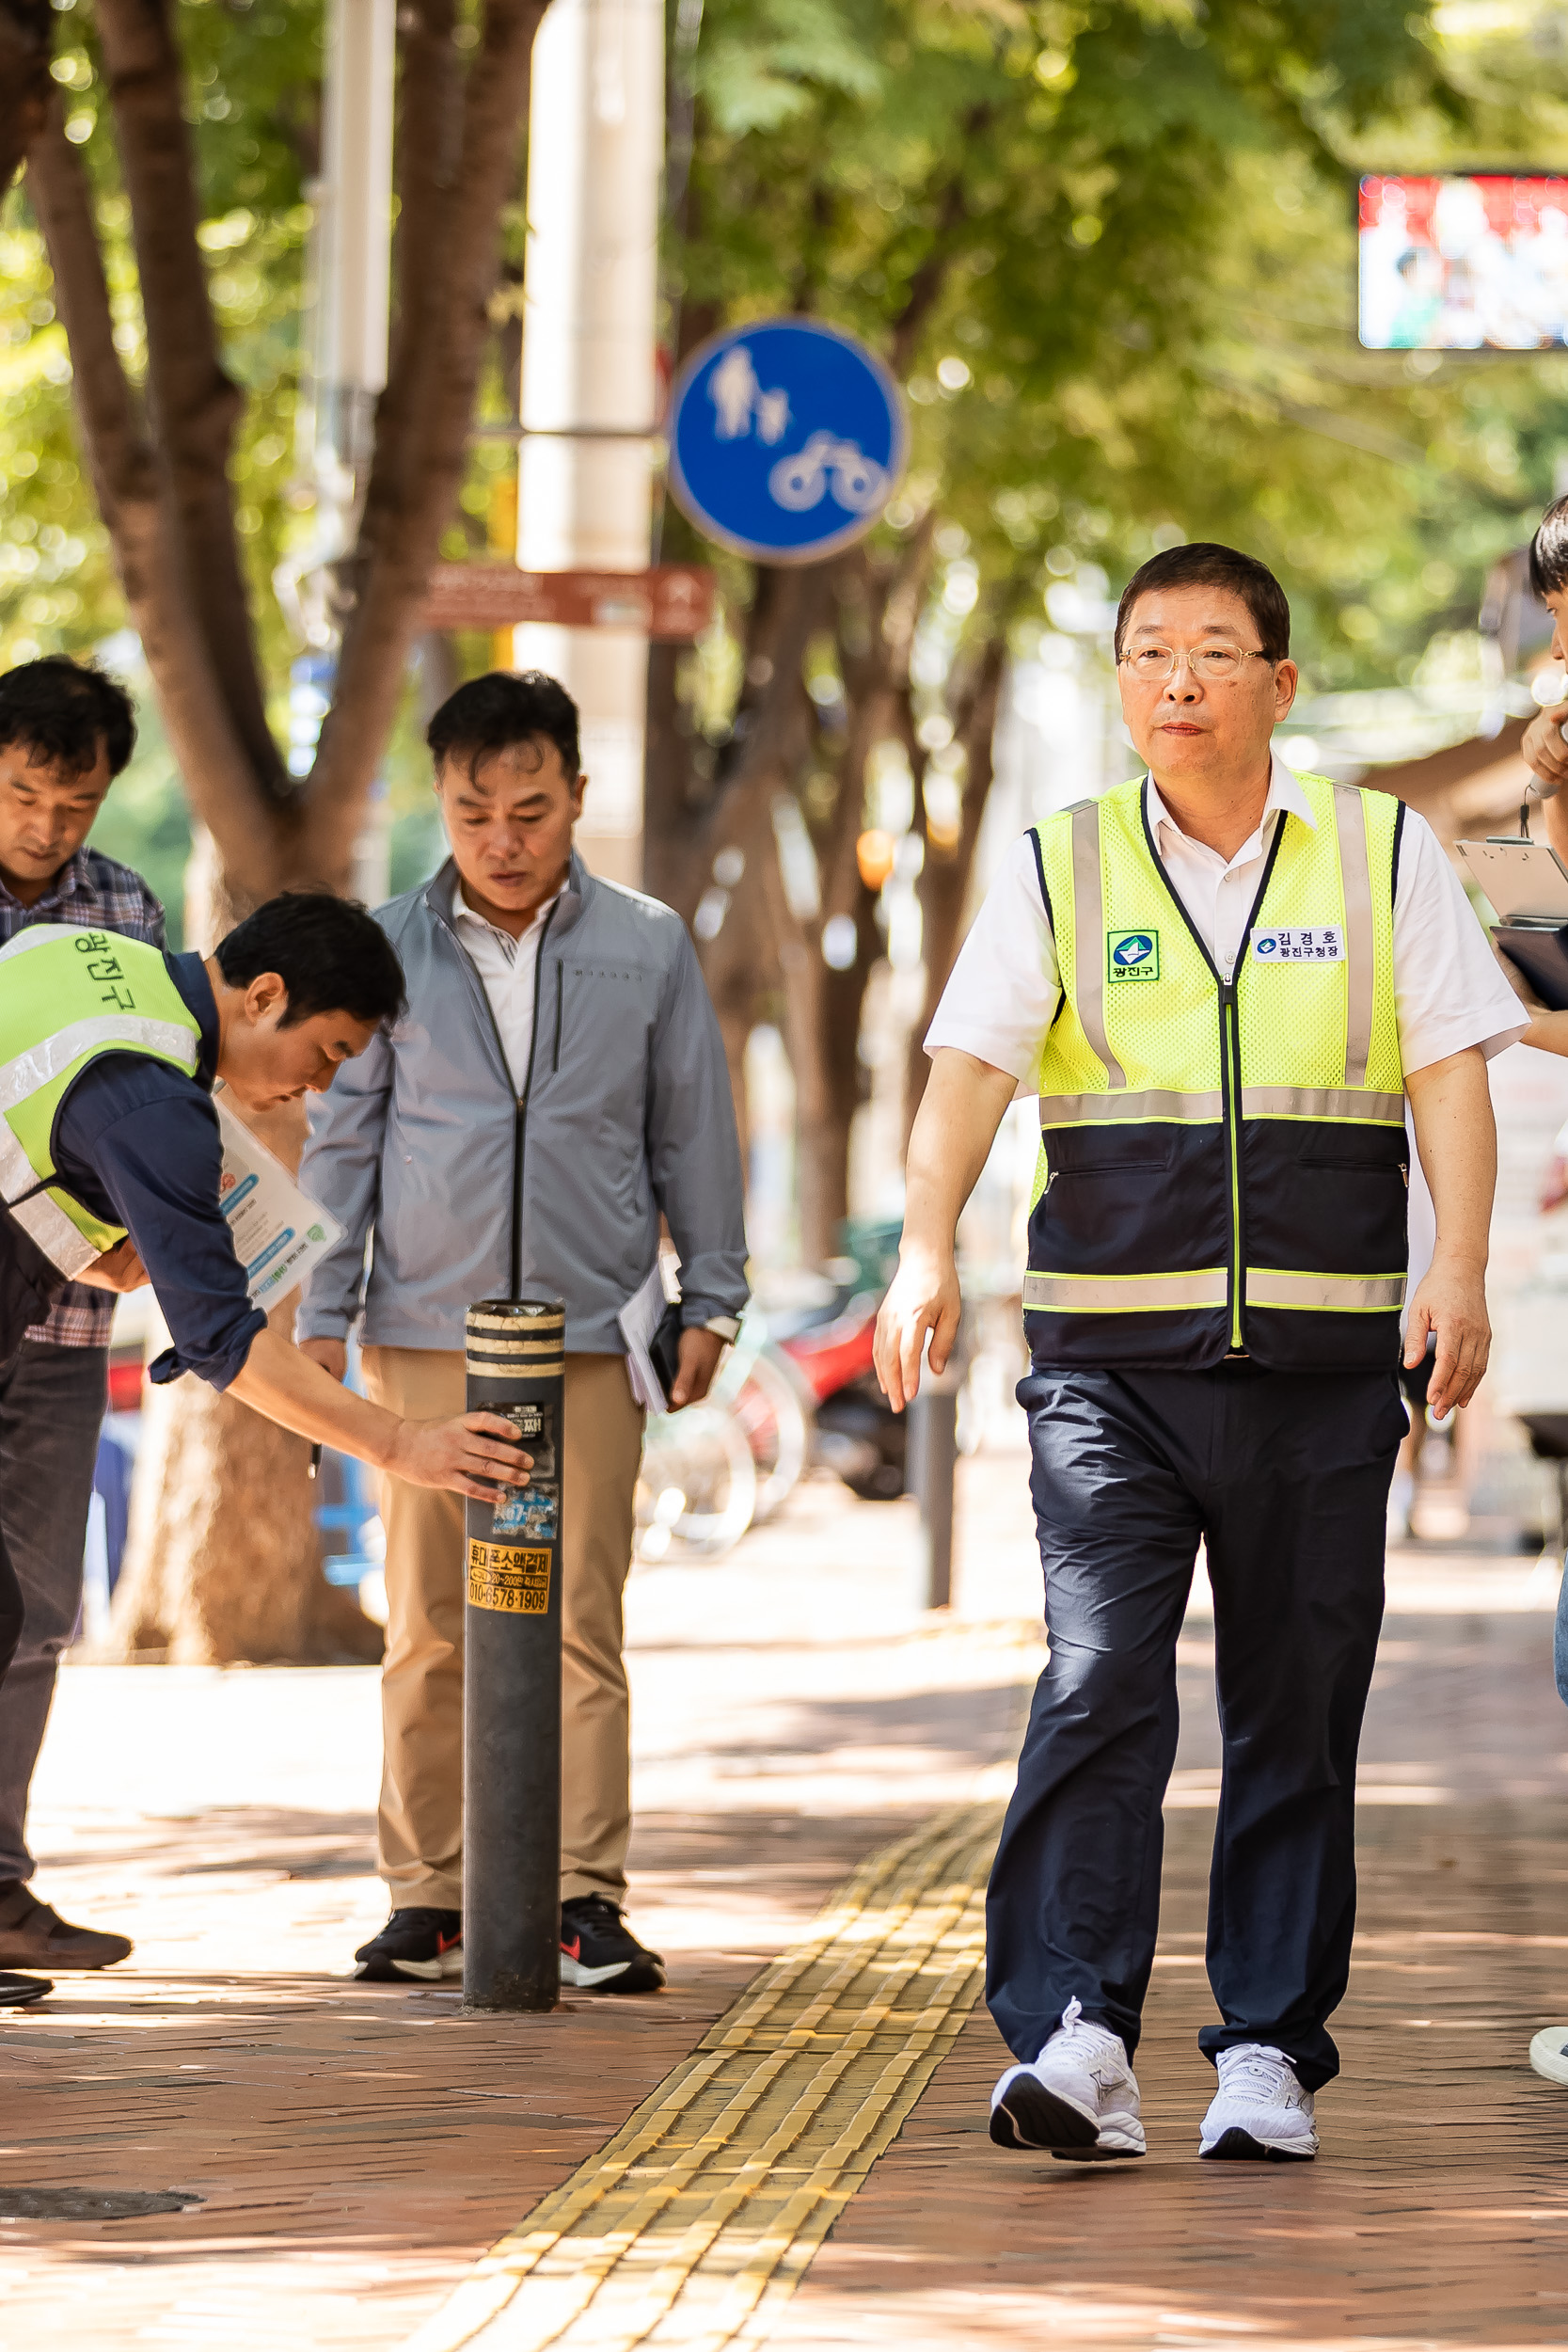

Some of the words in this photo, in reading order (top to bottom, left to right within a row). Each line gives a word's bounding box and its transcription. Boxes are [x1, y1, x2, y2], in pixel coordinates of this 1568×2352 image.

[1279, 945, 1338, 958] 광진구청장
[74, 932, 136, 1010] 광진구
[1112, 966, 1154, 977] 광진구
